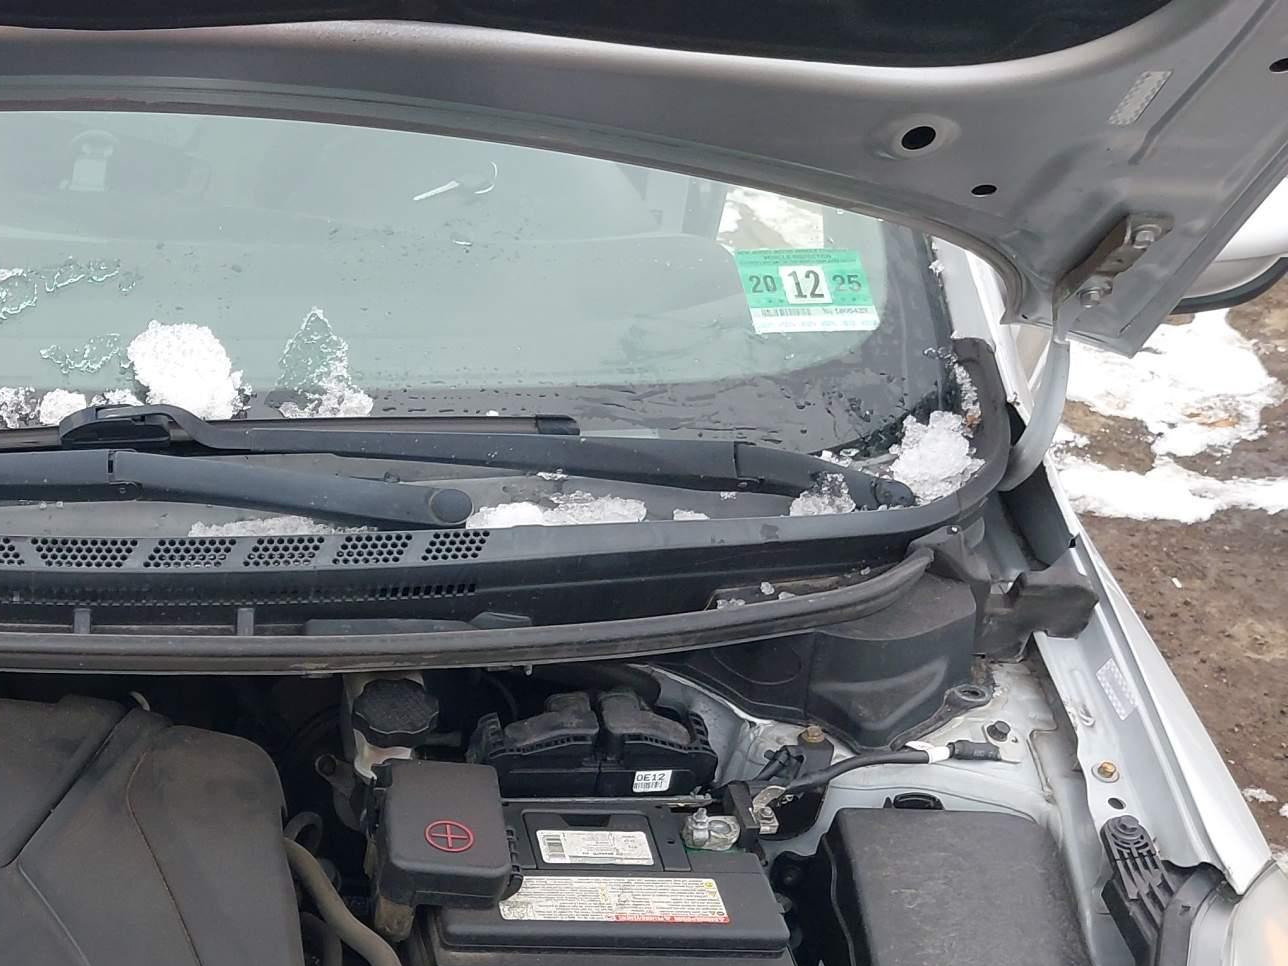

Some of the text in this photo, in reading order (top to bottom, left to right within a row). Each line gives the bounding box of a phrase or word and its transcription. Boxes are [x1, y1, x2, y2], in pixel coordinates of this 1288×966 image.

[748, 269, 862, 299] 20 12 25
